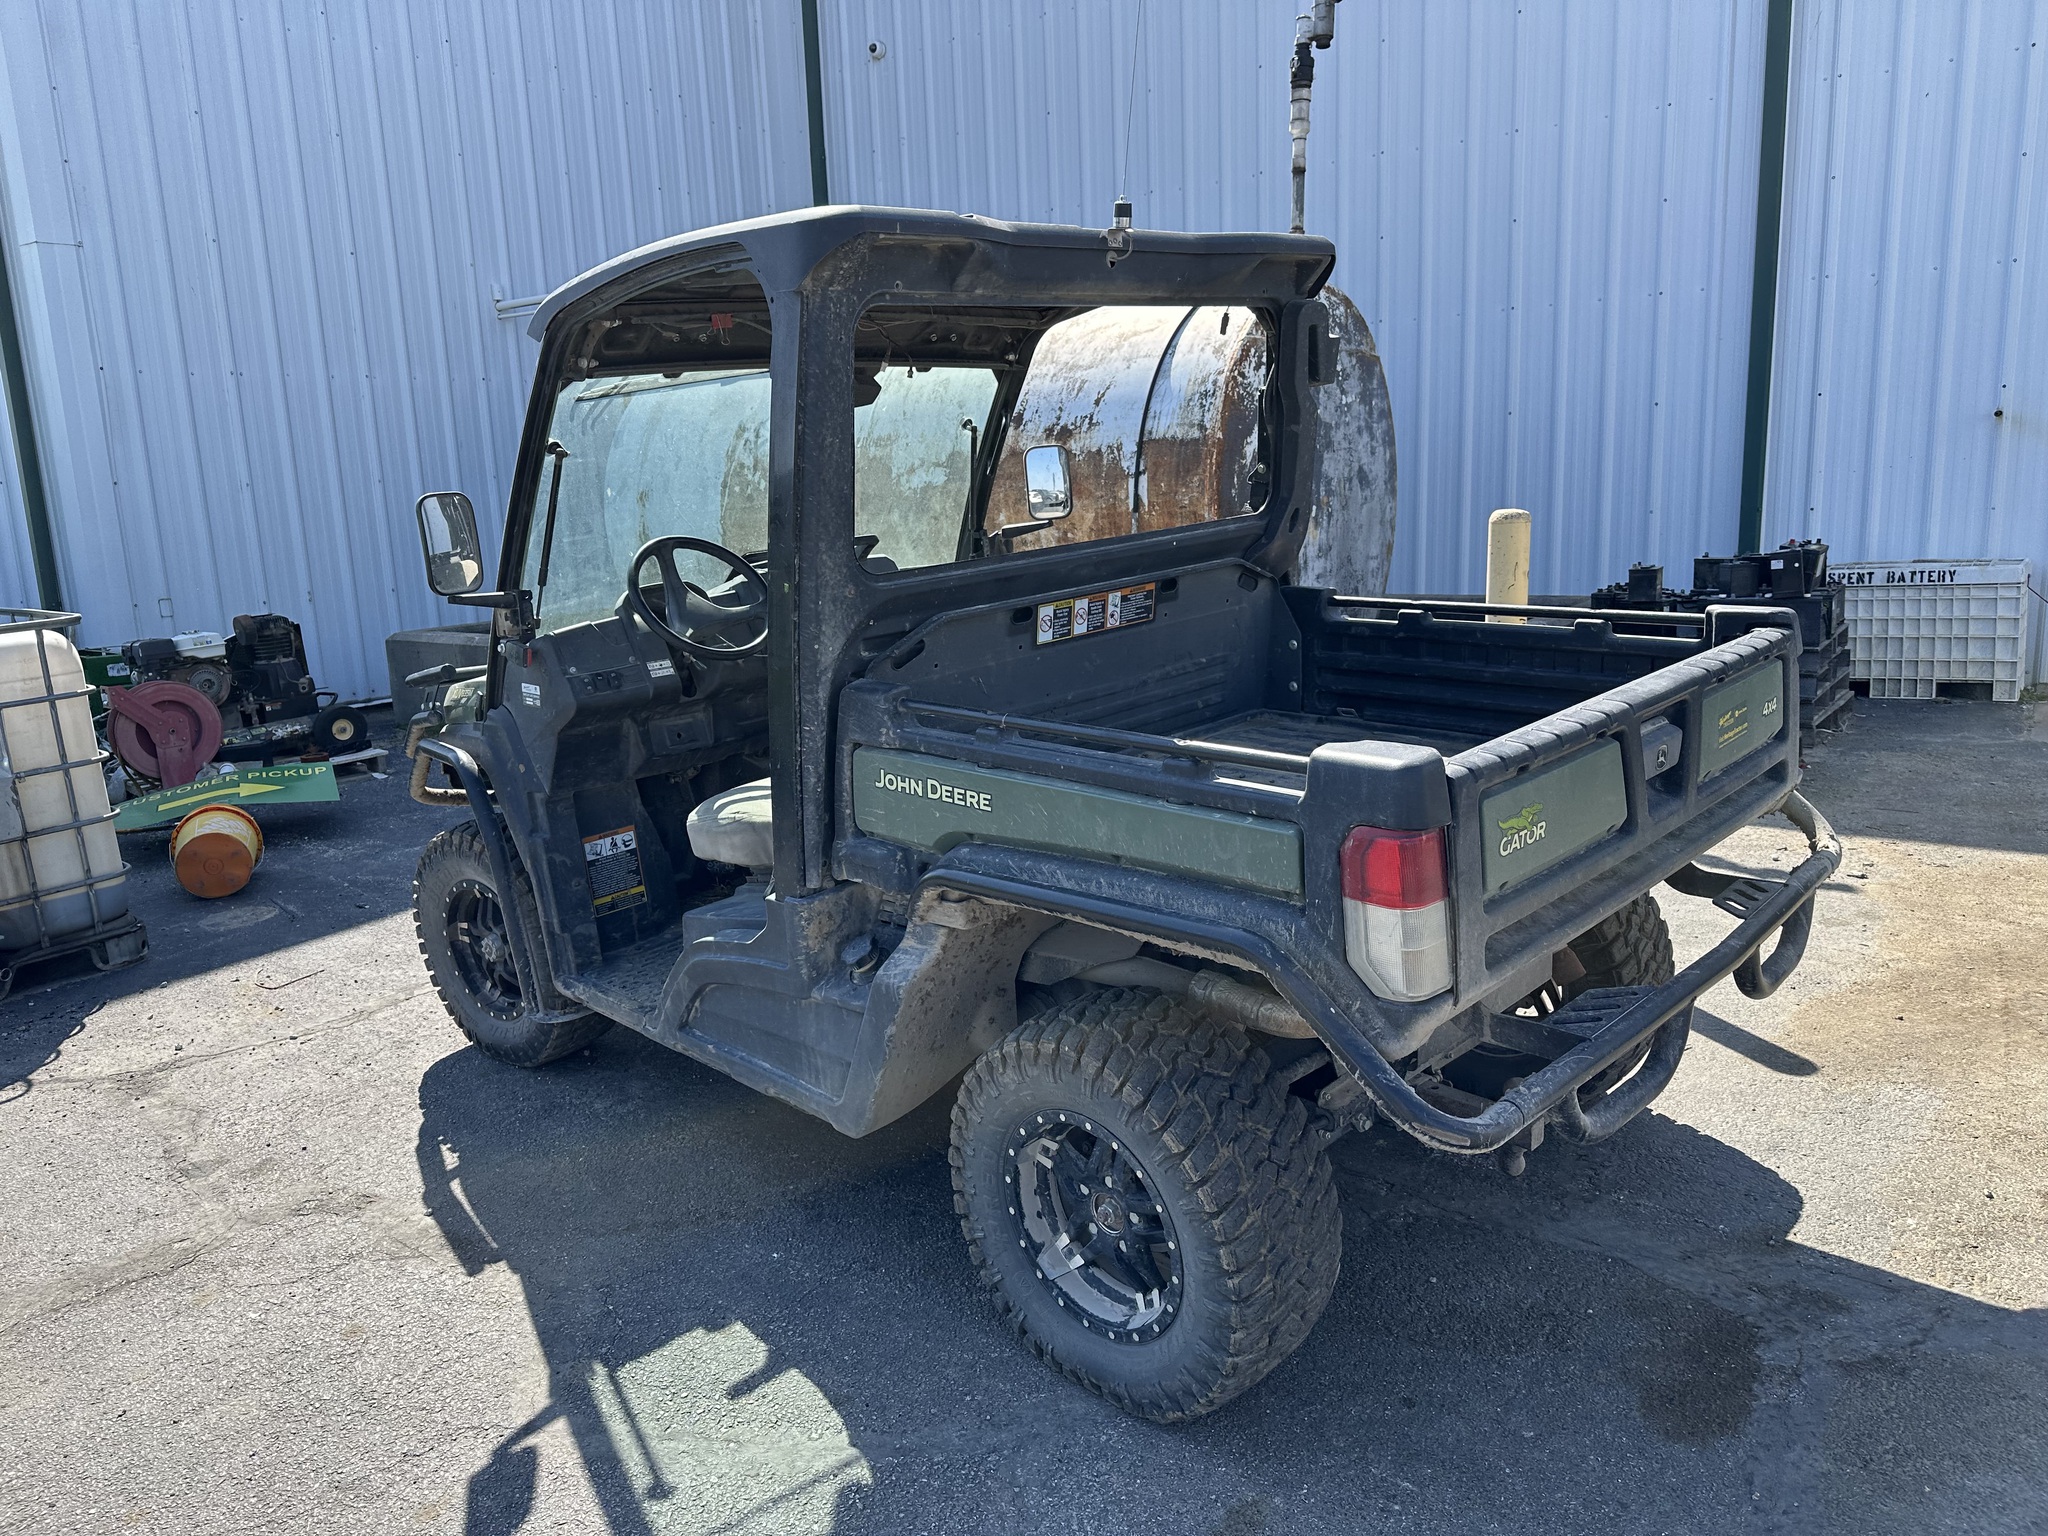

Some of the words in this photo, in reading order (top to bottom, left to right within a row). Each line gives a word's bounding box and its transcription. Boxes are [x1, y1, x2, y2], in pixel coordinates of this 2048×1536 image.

[1827, 571, 1875, 586] SPENT
[1886, 569, 1957, 584] BATTERY
[118, 774, 240, 810] CUSTOMER
[247, 766, 327, 779] PICKUP
[874, 768, 923, 797] JOHN
[926, 777, 993, 812] DEERE
[1499, 820, 1547, 857] GATOR
